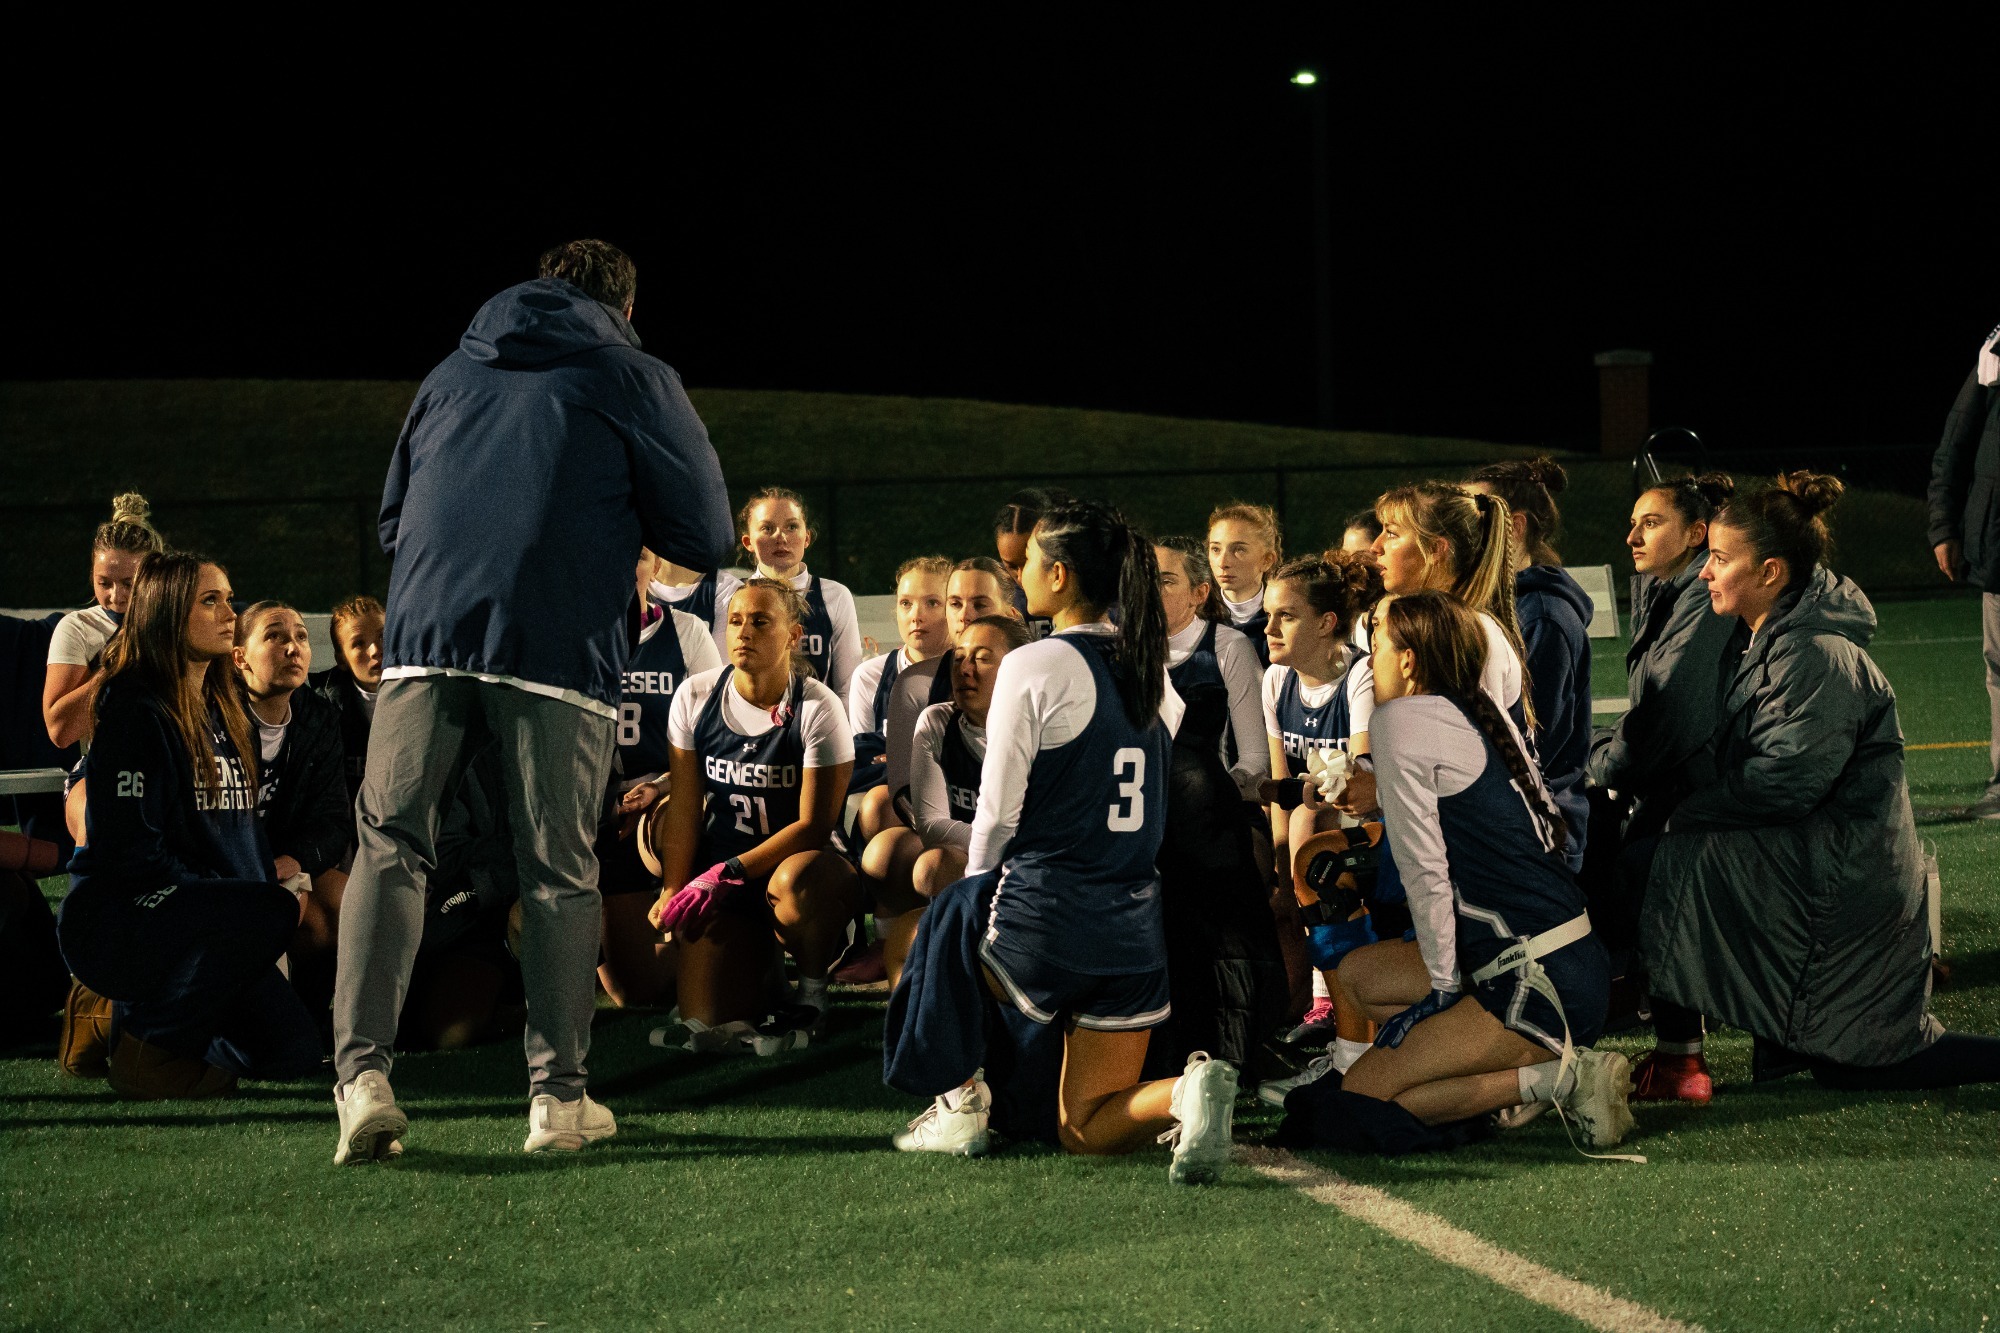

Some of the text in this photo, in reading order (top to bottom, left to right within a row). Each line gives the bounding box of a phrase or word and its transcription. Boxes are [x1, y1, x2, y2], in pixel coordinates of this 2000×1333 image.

[117, 770, 145, 798] 26
[706, 755, 797, 789] GENESEO
[1107, 747, 1146, 832] 3
[729, 793, 770, 836] 21
